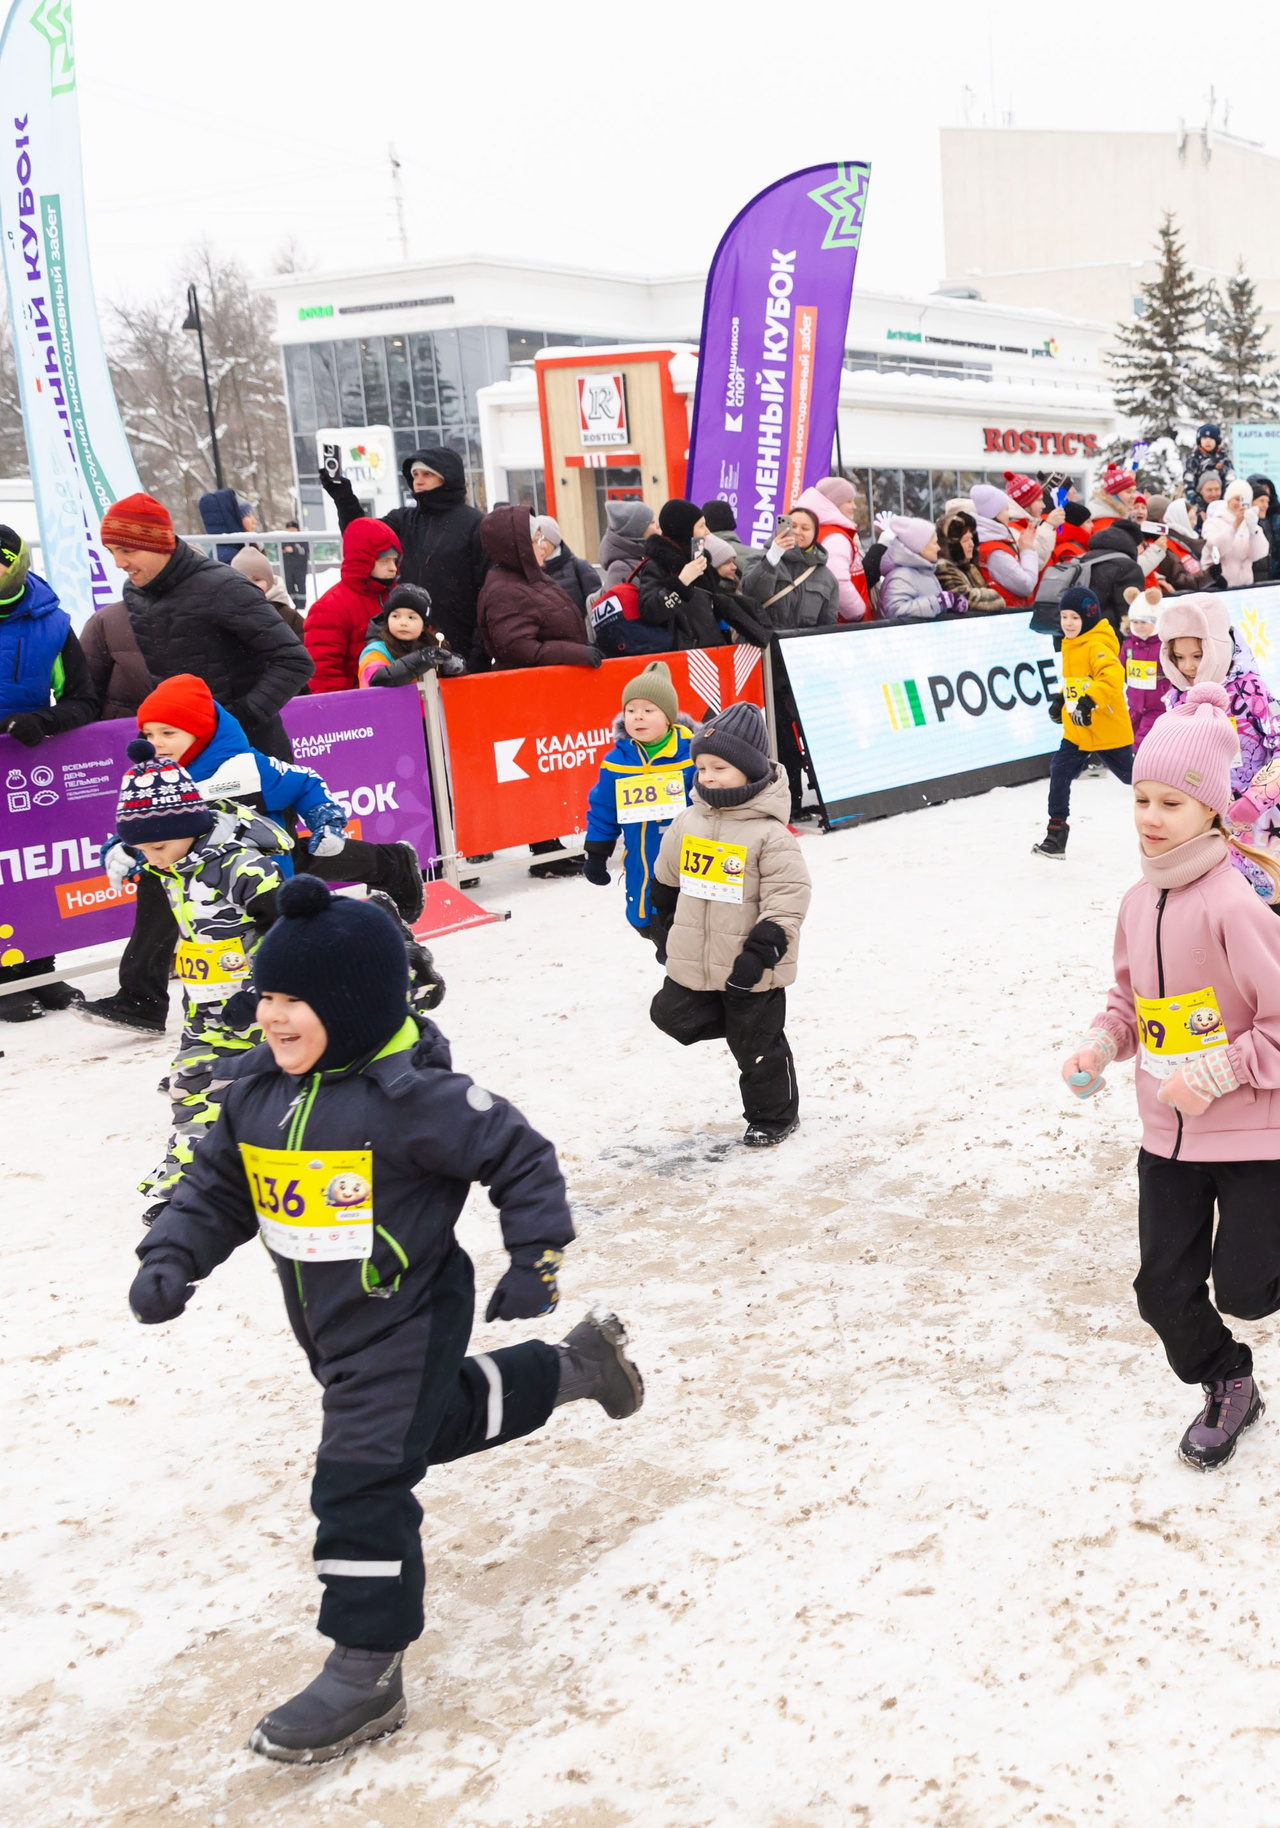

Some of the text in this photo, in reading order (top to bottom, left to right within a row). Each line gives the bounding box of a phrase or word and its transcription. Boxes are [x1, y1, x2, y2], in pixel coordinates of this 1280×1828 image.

[45, 203, 61, 261] забег
[48, 265, 83, 413] многодневный
[798, 312, 813, 352] забег
[725, 317, 740, 407] КАЛАШНИКОВ
[735, 366, 745, 408] СПОРТ
[750, 248, 797, 550] ЛЬМЕННЫЙ КУБОК
[795, 355, 811, 454] многодневный
[583, 432, 625, 442] ROSTIC'S
[983, 427, 1099, 457] ROSTIC'S
[927, 658, 1061, 722] РОССЕ
[292, 726, 374, 749] КАЛАШНИКОВ
[293, 743, 332, 759] СПОРТ
[535, 727, 616, 756] КАЛАШН
[62, 758, 114, 772] ВСЕМИРНЫЙ
[537, 747, 597, 773] СПОРТ
[64, 771, 87, 781] ДЕНЬ
[64, 775, 110, 788] ПЕЛЬМЕНЯ
[123, 799, 151, 809] HO!
[152, 795, 182, 806] HO!
[622, 785, 658, 806] 128
[0, 833, 113, 886] ПЕЛЬ
[331, 781, 400, 819] БОК
[683, 850, 715, 876] 137
[66, 882, 137, 910] Нового
[179, 956, 209, 980] 129
[1139, 1014, 1166, 1049] 99
[252, 1172, 306, 1218] 136
